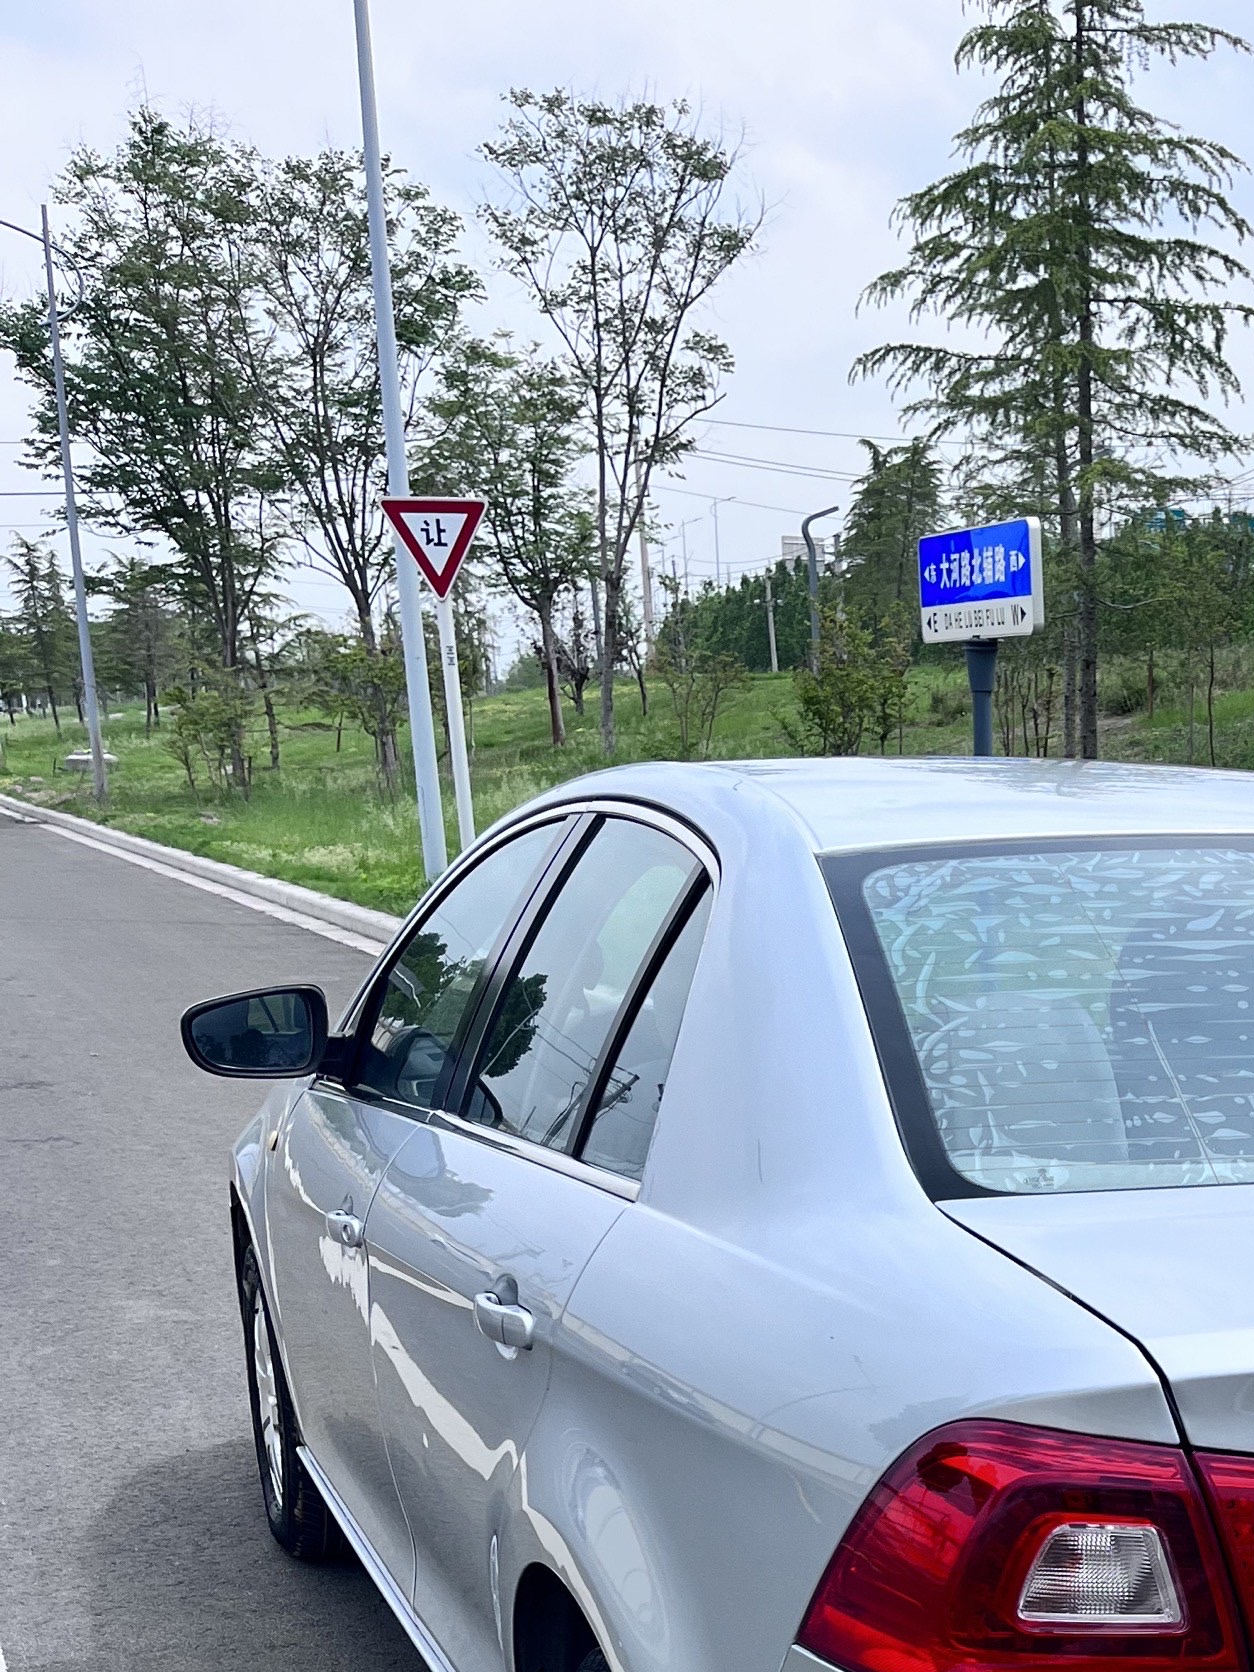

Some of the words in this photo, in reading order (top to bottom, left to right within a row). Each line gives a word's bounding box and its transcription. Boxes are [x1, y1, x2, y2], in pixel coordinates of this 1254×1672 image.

[420, 518, 448, 547] 让
[932, 612, 938, 633] E
[1010, 604, 1020, 626] W
